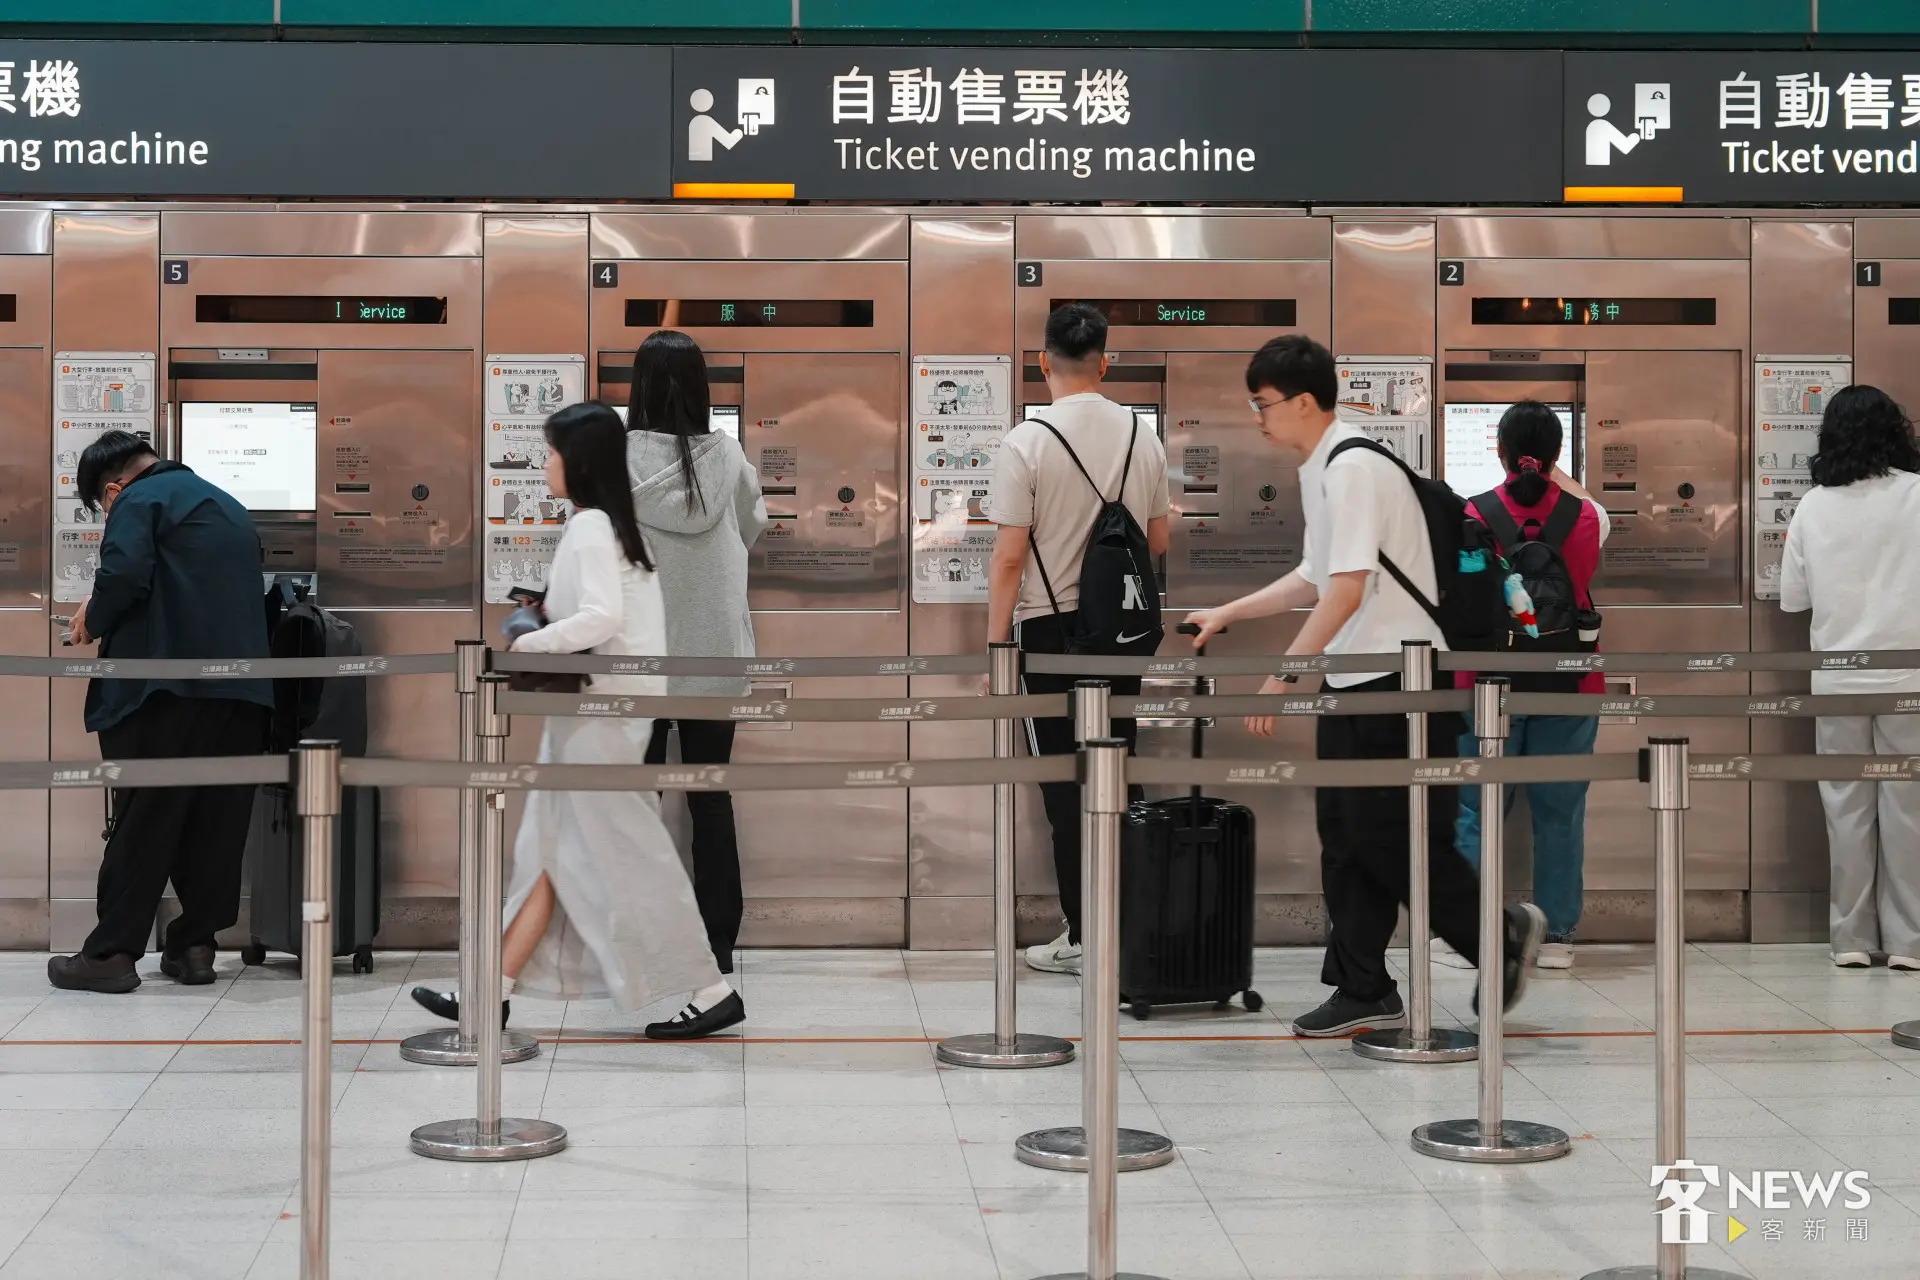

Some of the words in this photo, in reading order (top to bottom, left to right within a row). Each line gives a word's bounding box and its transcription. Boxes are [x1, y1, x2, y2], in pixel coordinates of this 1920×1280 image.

[832, 66, 1131, 125] 自動售票機
[54, 131, 208, 165] machine
[834, 138, 939, 171] Ticket
[950, 138, 1094, 178] vending
[1104, 139, 1256, 172] machine
[1721, 140, 1825, 173] Ticket
[170, 264, 182, 281] 5
[600, 266, 612, 283] 4
[1025, 266, 1036, 282] 3
[1446, 264, 1458, 282] 2
[1864, 266, 1872, 282] 1
[1158, 304, 1206, 321] Service
[62, 533, 79, 541] 行李
[82, 533, 100, 541] 123
[494, 536, 510, 545] 尊重
[533, 536, 560, 545] 一路好
[1764, 532, 1780, 541] 行李
[732, 706, 762, 714] 台灣高鐵
[881, 707, 912, 715] 台灣高鐵
[1284, 701, 1314, 710] 台灣高鐵
[1748, 702, 1777, 710] 台灣高鐵
[1414, 767, 1450, 777] 台灣高鐵
[1864, 764, 1898, 773] 台灣高鐵
